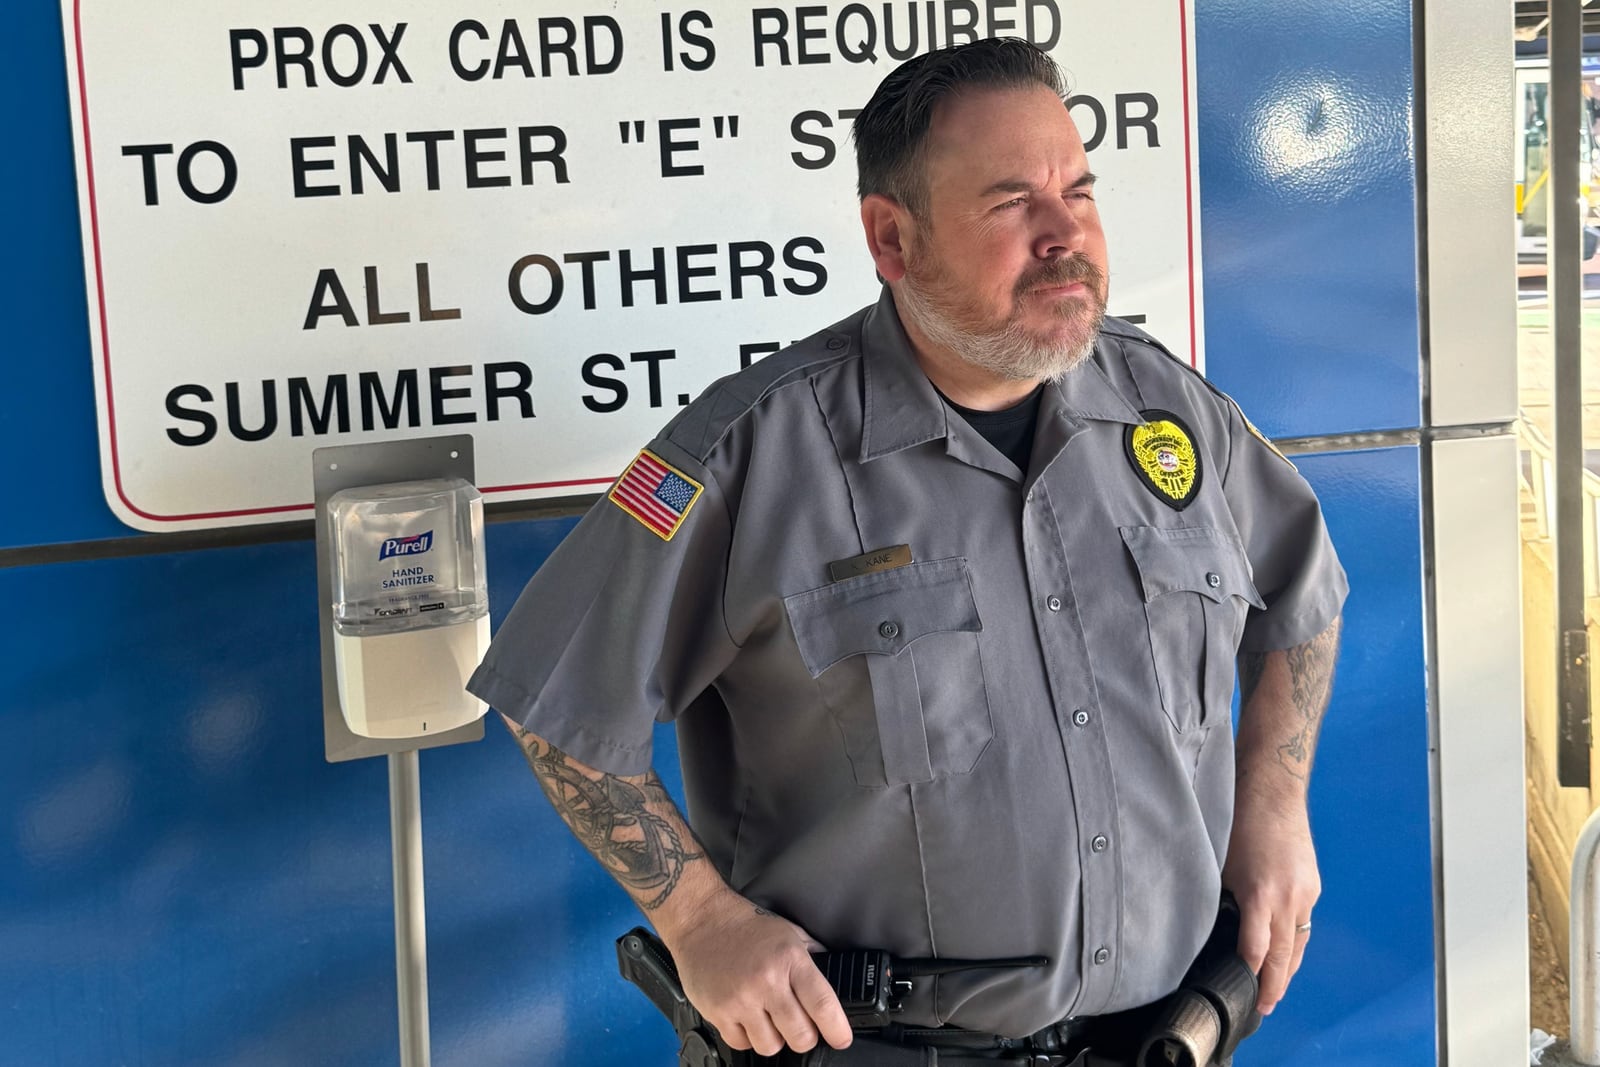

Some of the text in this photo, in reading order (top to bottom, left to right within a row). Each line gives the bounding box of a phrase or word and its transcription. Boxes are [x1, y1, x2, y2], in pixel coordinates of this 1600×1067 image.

[228, 0, 1062, 90] PROX CARD IS REQUIRED
[121, 139, 238, 206] TO
[290, 126, 571, 199] ENTER
[619, 115, 739, 178] "E"
[1062, 92, 1161, 153] OR
[302, 236, 828, 331] ALL OTHERS
[164, 349, 690, 447] SUMMER ST.
[382, 575, 434, 588] SANITIZER
[392, 567, 424, 577] HAND
